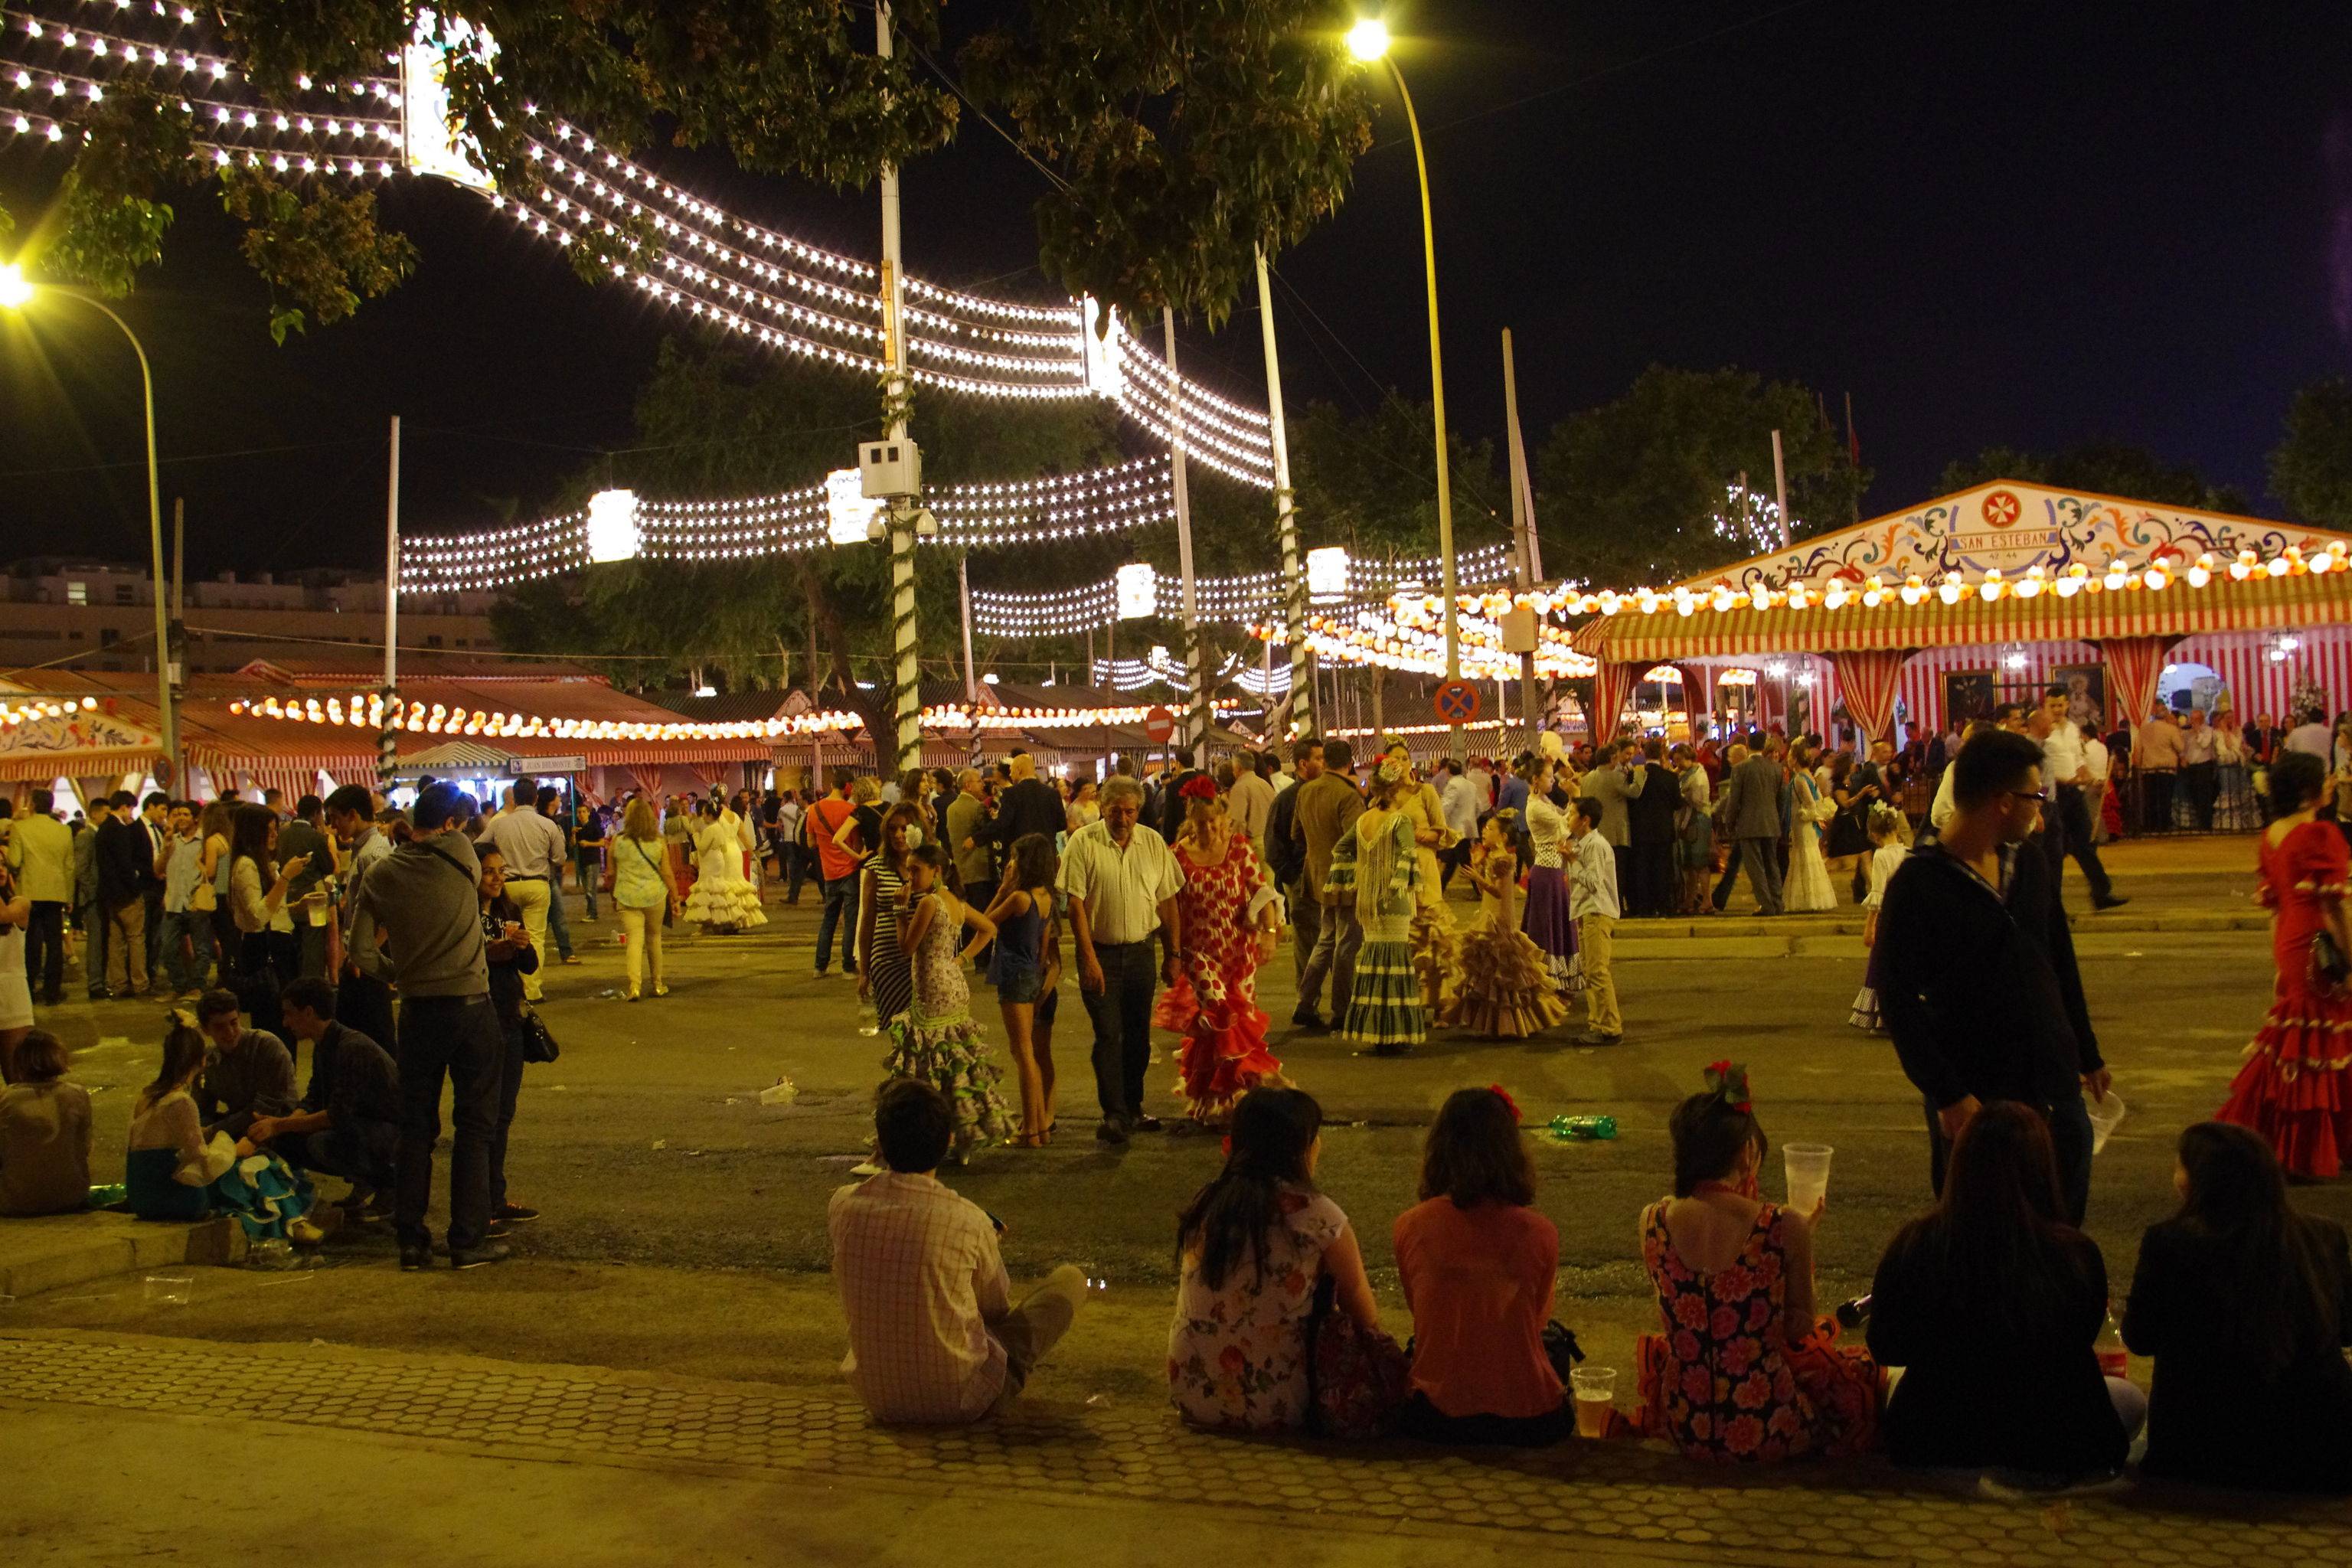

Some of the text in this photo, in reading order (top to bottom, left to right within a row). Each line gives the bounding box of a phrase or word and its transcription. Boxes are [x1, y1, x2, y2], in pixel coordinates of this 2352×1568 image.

[1960, 533, 2047, 549] SAN ESTEBAN
[526, 760, 541, 769] JUAN
